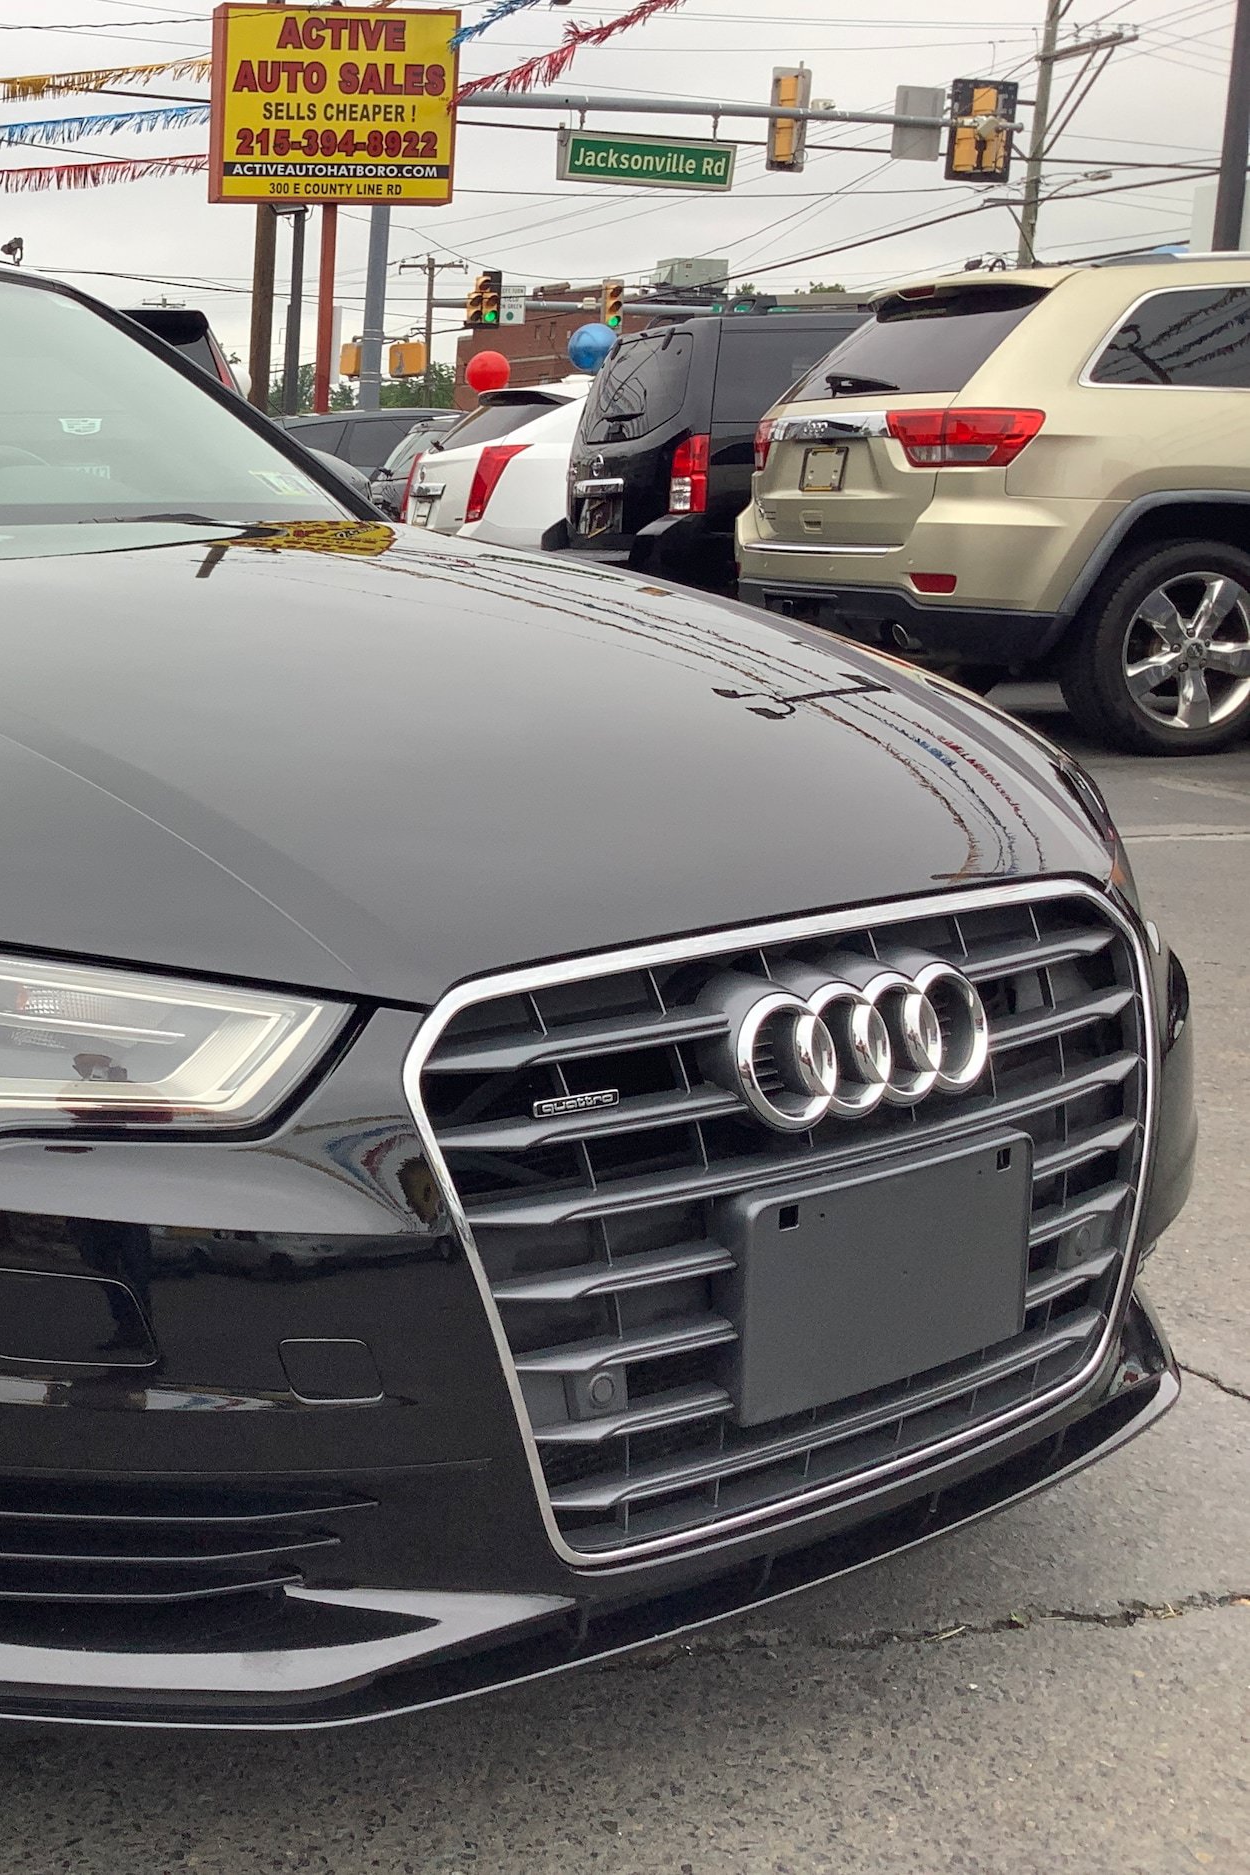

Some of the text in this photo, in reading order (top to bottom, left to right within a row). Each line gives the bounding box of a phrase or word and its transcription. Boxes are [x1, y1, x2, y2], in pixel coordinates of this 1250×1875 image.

[276, 16, 406, 52] ACTIVE
[232, 60, 446, 97] AUTO SALES
[263, 102, 317, 121] SELLS
[323, 103, 405, 122] CHEAPER
[235, 127, 438, 158] 215-394-8922
[232, 164, 438, 178] ACTIVEAUTOHATBORO.COM
[574, 147, 726, 176] Jacksonville Rd
[269, 183, 402, 196] 300 E COUNTY LINE RD
[541, 1093, 614, 1114] quattro
